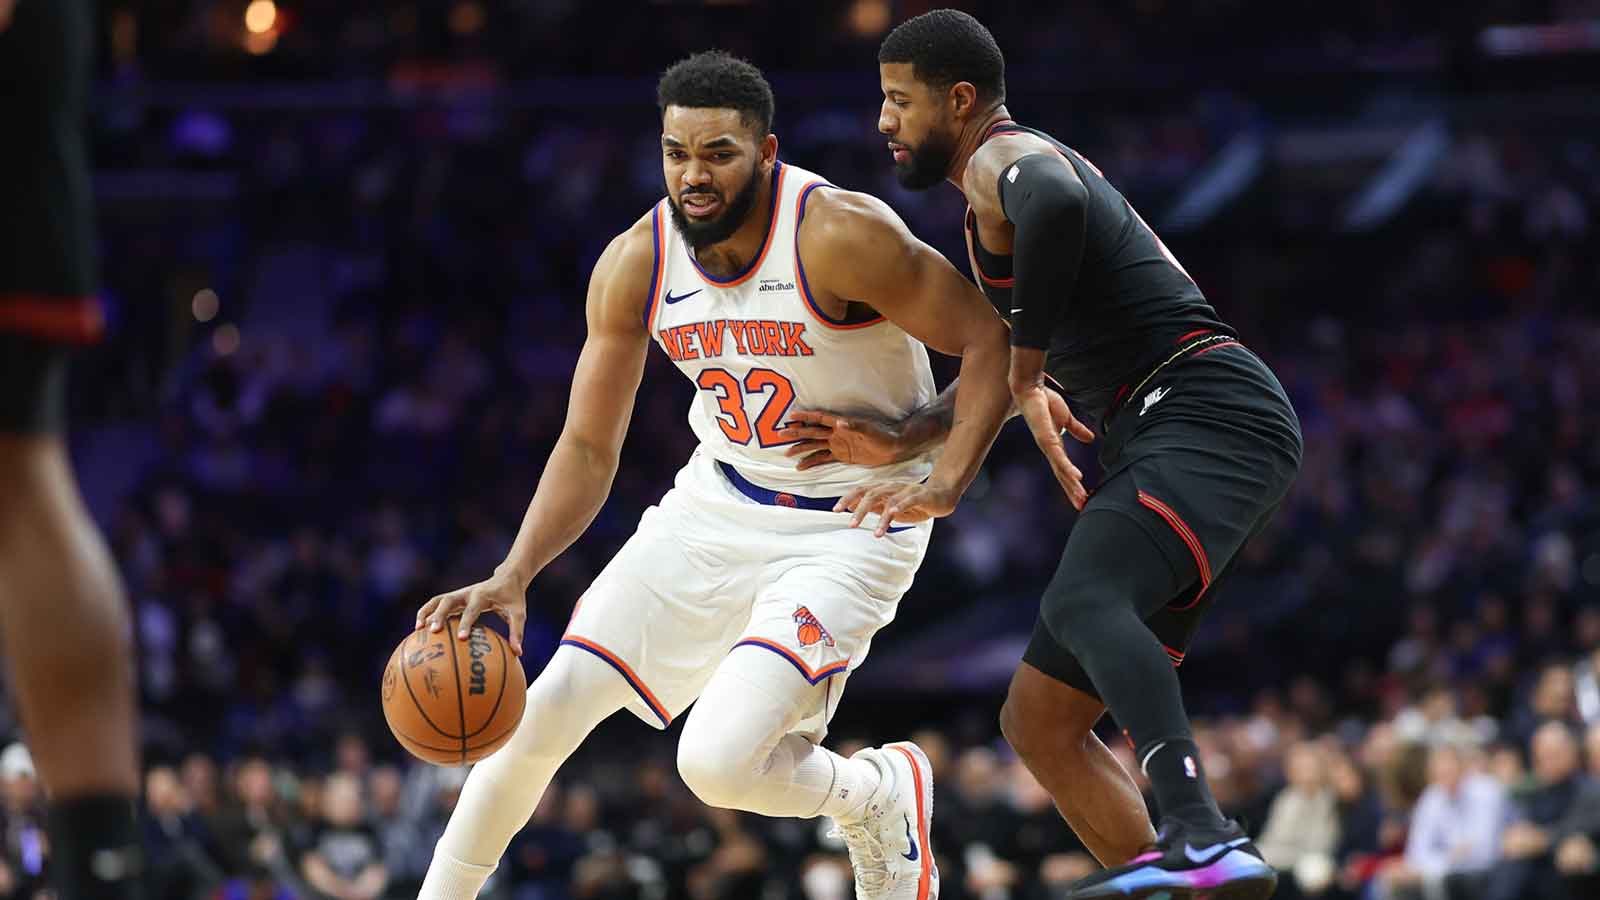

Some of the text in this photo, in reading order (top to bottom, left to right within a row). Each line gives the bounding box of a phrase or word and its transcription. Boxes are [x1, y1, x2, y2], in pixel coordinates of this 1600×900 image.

[659, 319, 815, 362] NEW YORK
[696, 367, 806, 449] 32
[469, 624, 493, 697] ilson
